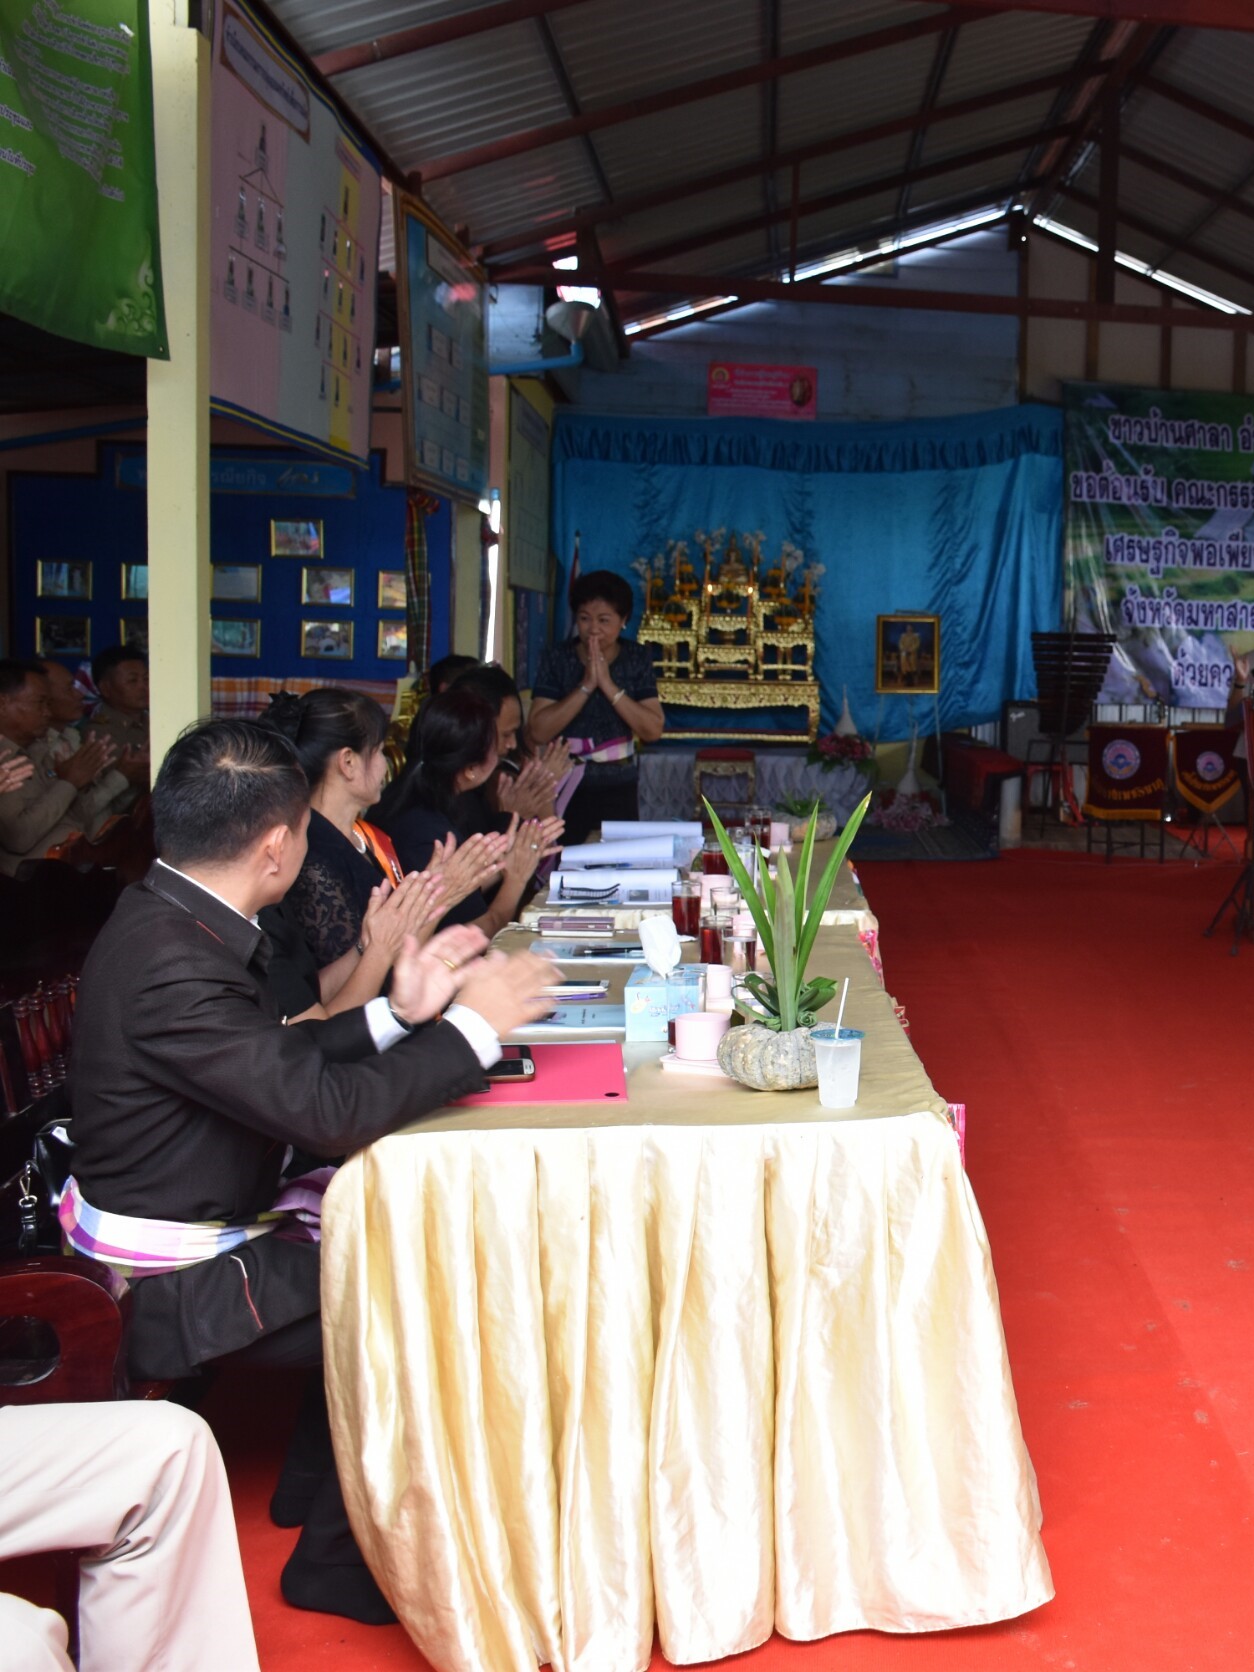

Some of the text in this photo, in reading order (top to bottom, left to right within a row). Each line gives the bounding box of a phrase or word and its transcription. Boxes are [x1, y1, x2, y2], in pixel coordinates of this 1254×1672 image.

[1109, 407, 1232, 450] ชาวบ้านศาลา
[1071, 460, 1167, 505] ขอต้อนรับ
